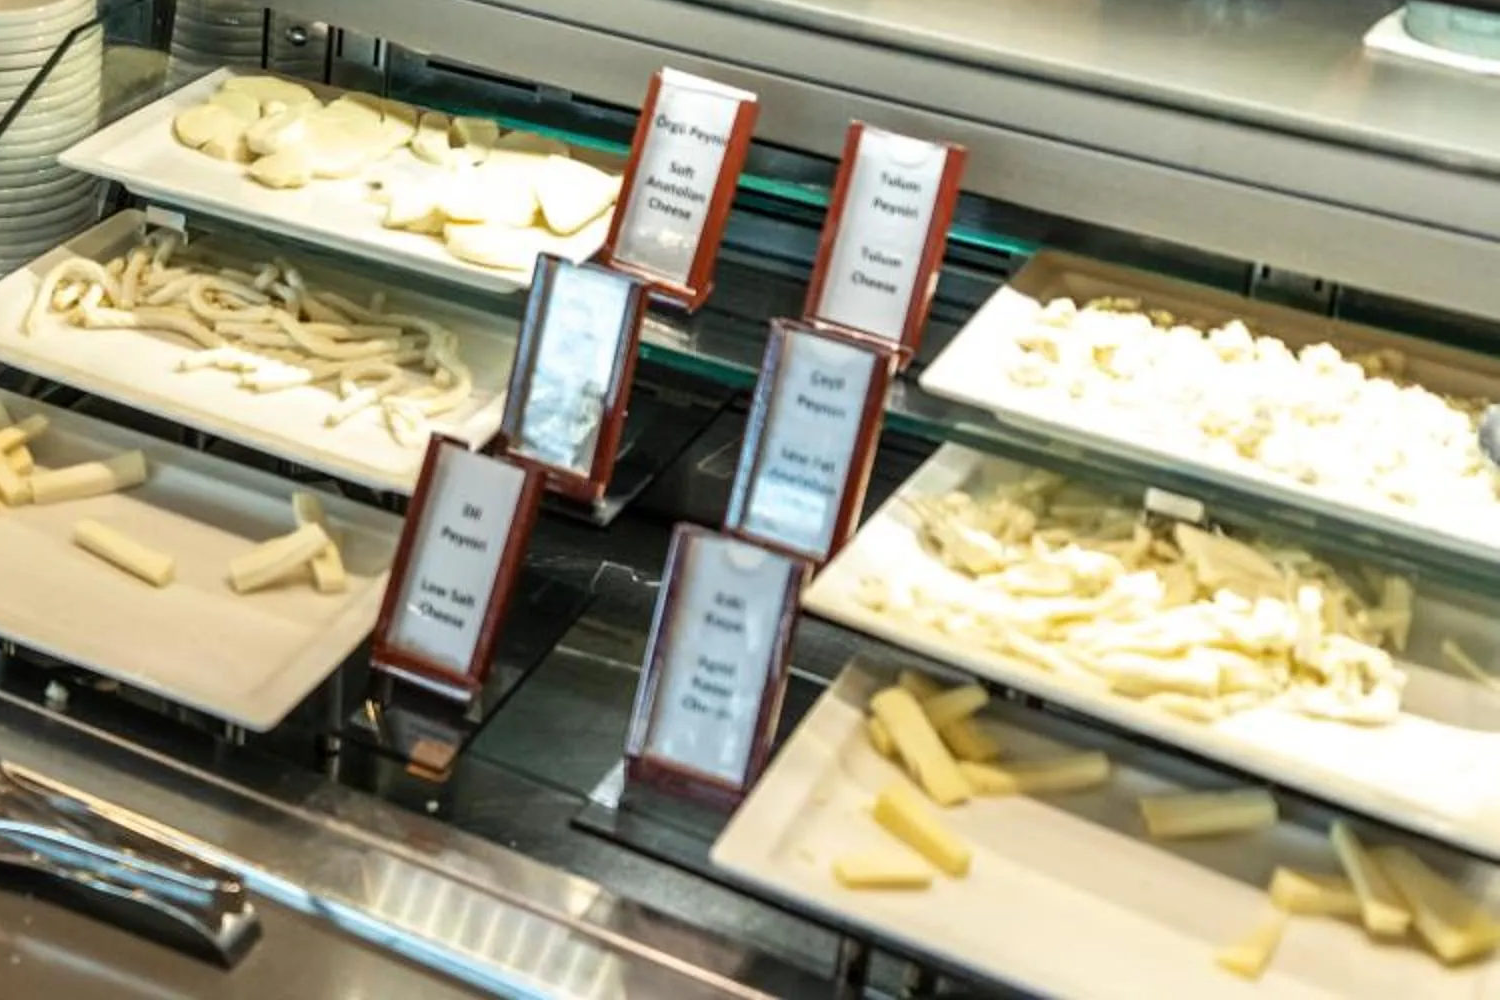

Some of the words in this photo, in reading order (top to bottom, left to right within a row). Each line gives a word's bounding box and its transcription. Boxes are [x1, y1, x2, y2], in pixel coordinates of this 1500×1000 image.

[670, 161, 695, 179] Soft
[881, 172, 921, 191] Tulum
[646, 177, 706, 203] Anatolian
[649, 197, 691, 220] Cheese
[862, 248, 902, 267] Tulum
[852, 271, 897, 294] Cheese
[462, 503, 482, 520] Dil
[421, 578, 446, 598] Low
[451, 586, 475, 607] Salt
[419, 601, 465, 629] Cheese
